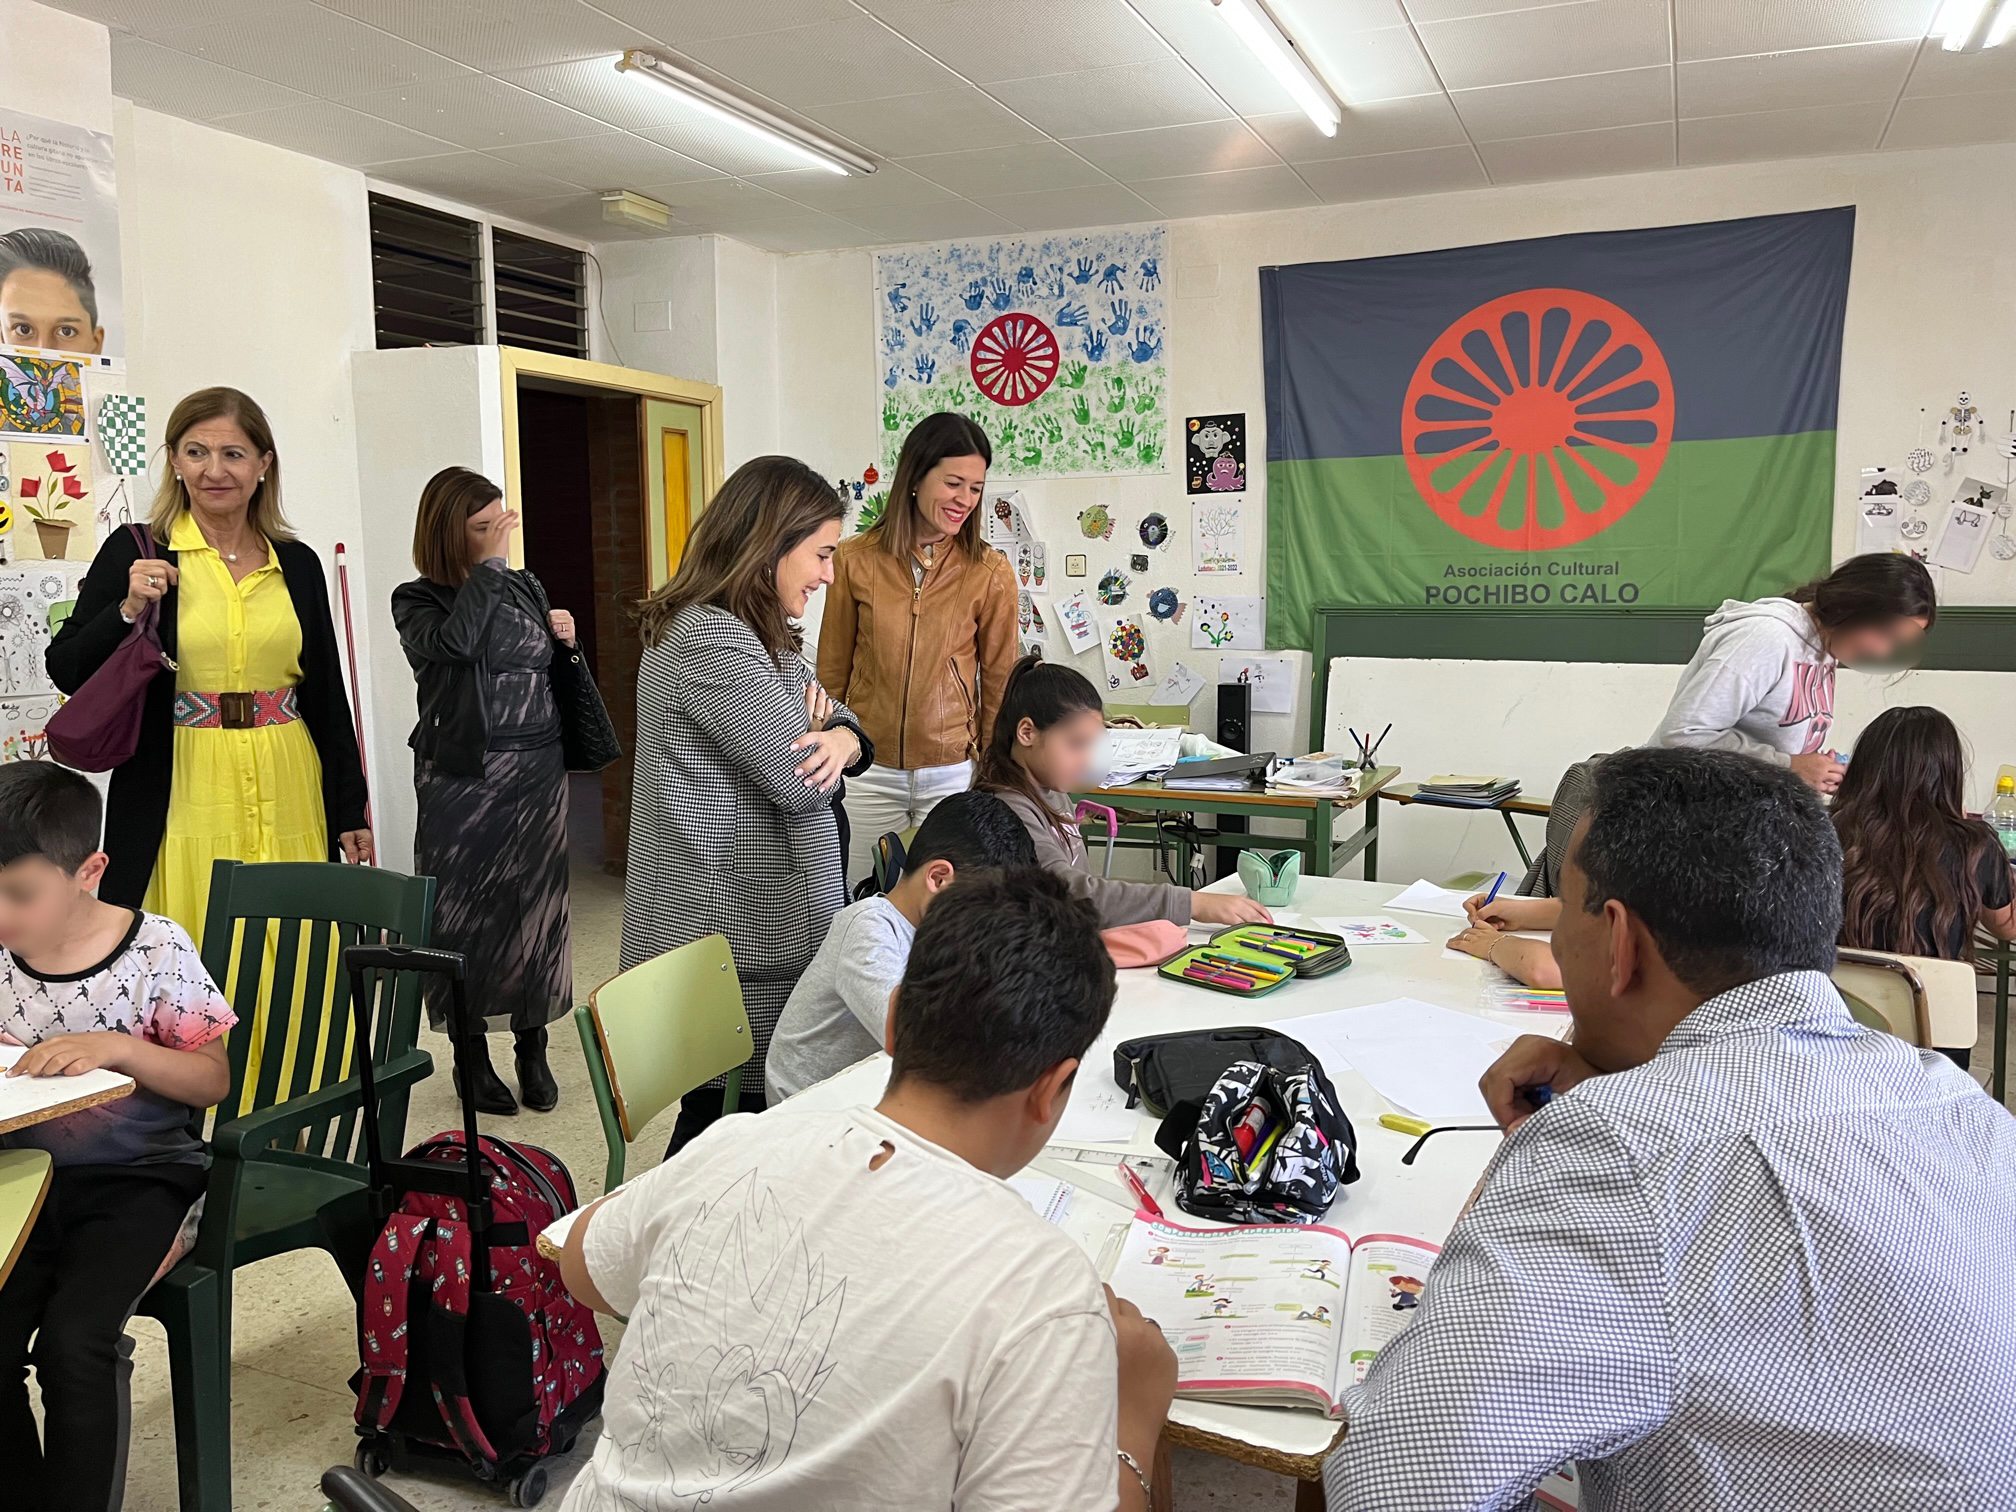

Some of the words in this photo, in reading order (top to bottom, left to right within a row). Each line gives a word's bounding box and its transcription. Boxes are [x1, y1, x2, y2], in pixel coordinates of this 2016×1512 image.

[1, 126, 22, 144] LA
[26, 143, 48, 152] cultura
[4, 177, 24, 194] TA
[1443, 562, 1542, 578] Asociación
[1547, 561, 1620, 577] Cultural
[1424, 583, 1551, 605] POCHIBO
[1559, 582, 1640, 604] CALO
